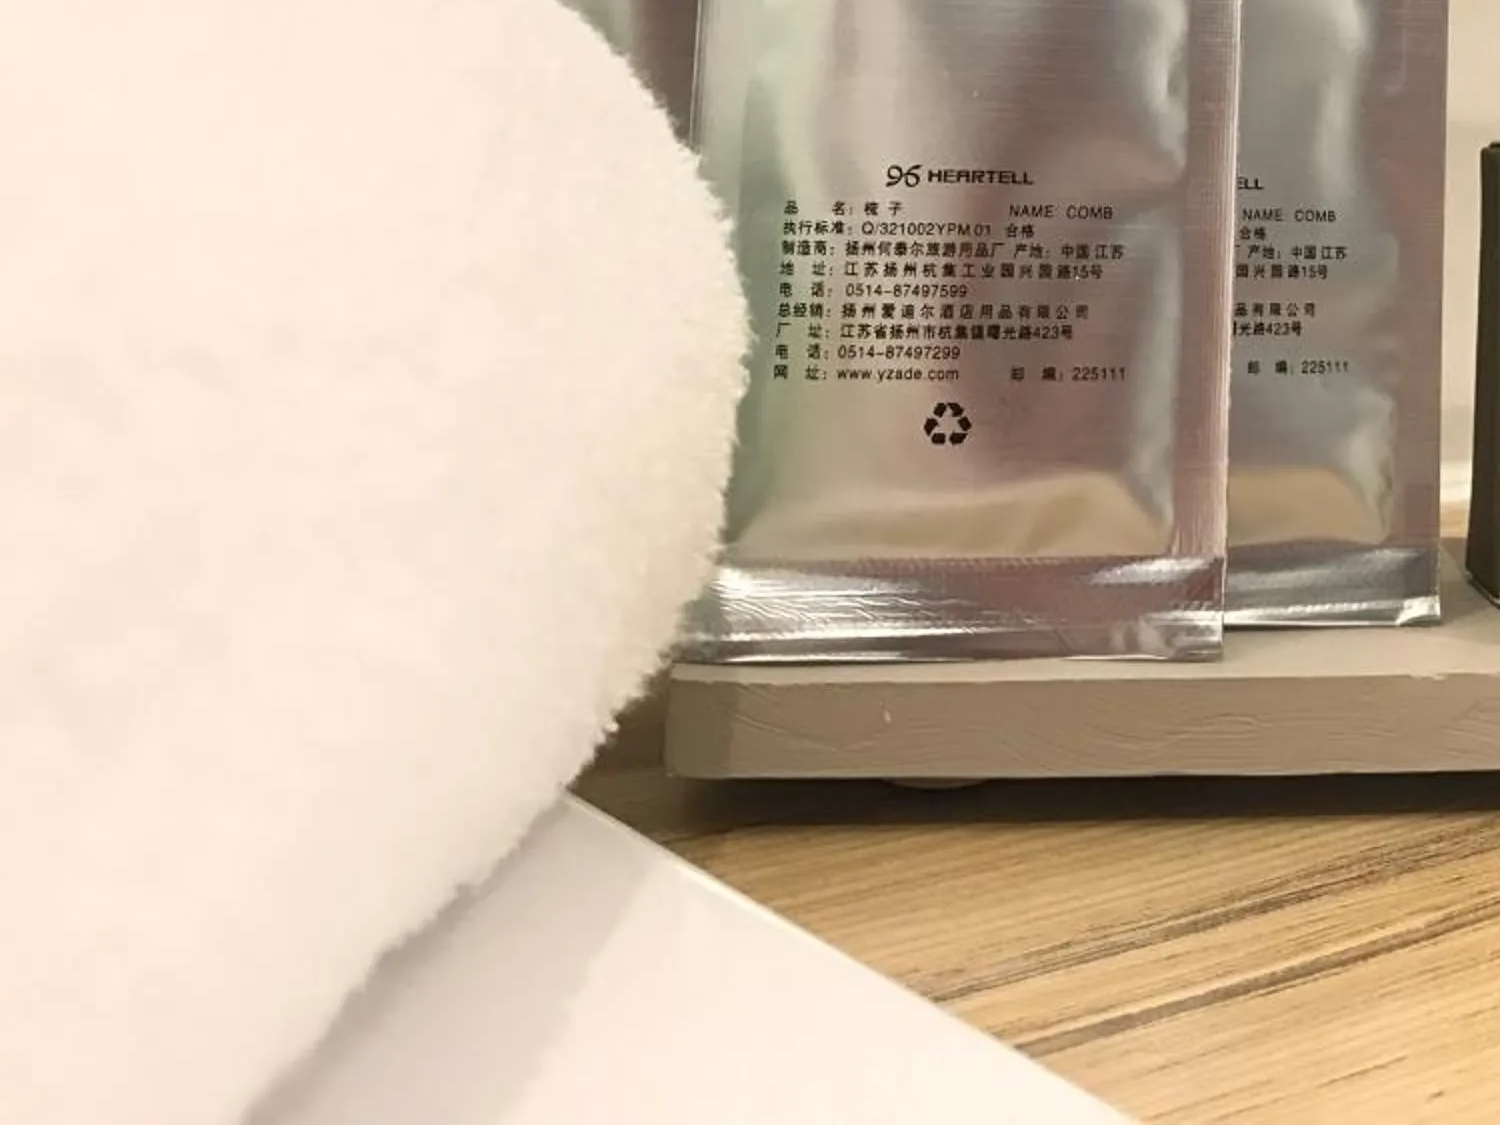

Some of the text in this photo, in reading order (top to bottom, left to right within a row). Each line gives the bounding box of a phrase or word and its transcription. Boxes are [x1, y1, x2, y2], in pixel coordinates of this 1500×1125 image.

[927, 169, 1035, 186] HEARTELL
[1009, 204, 1114, 220] NAME COMB
[1242, 208, 1337, 223] NAME COMB
[1061, 243, 1125, 260] 中国江苏
[845, 282, 968, 298] 0514-87497599
[837, 344, 961, 360] 0514-87497299
[836, 365, 960, 383] www.yzade.com
[1071, 366, 1126, 381] 225111
